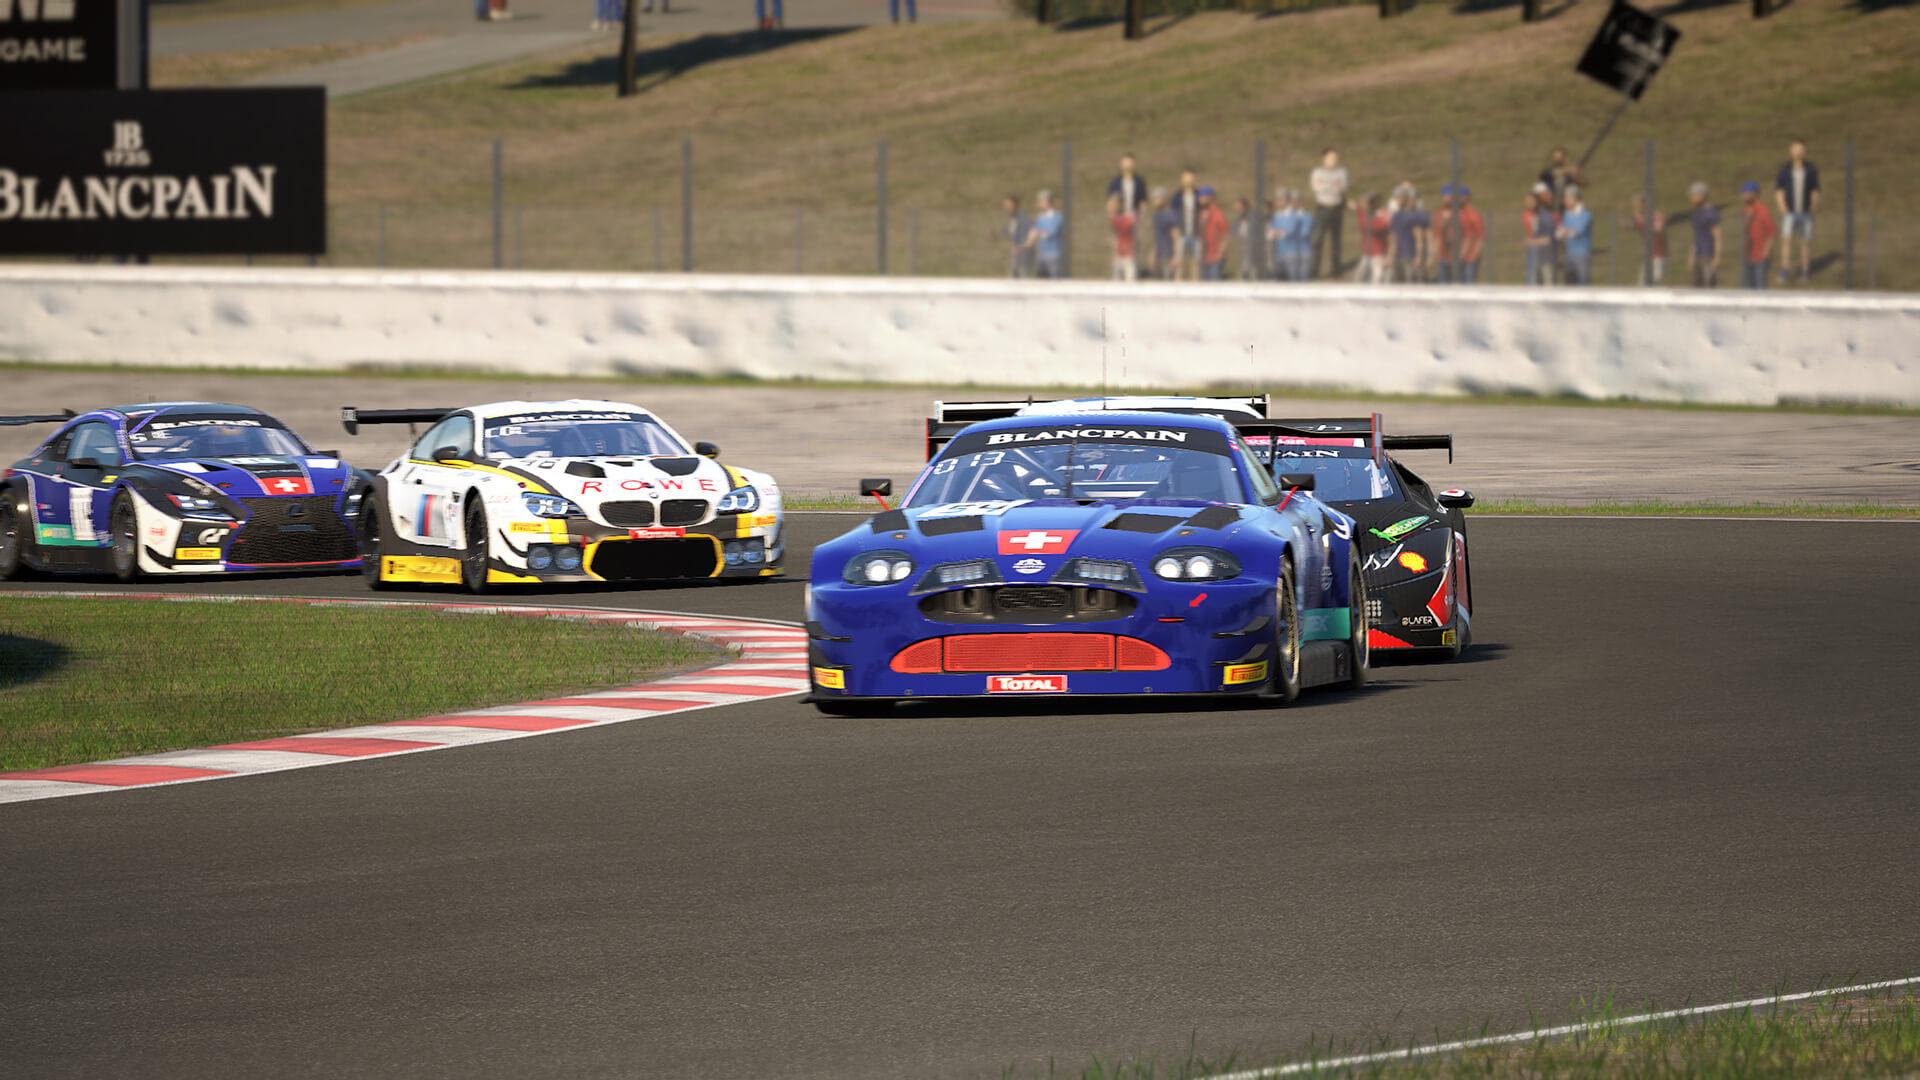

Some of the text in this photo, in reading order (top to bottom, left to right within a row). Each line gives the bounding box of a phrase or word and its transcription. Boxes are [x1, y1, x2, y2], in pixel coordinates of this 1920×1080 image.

[986, 429, 1188, 445] BLANCPAIN
[581, 479, 718, 495] ROWE
[996, 678, 1058, 690] TOTAL
